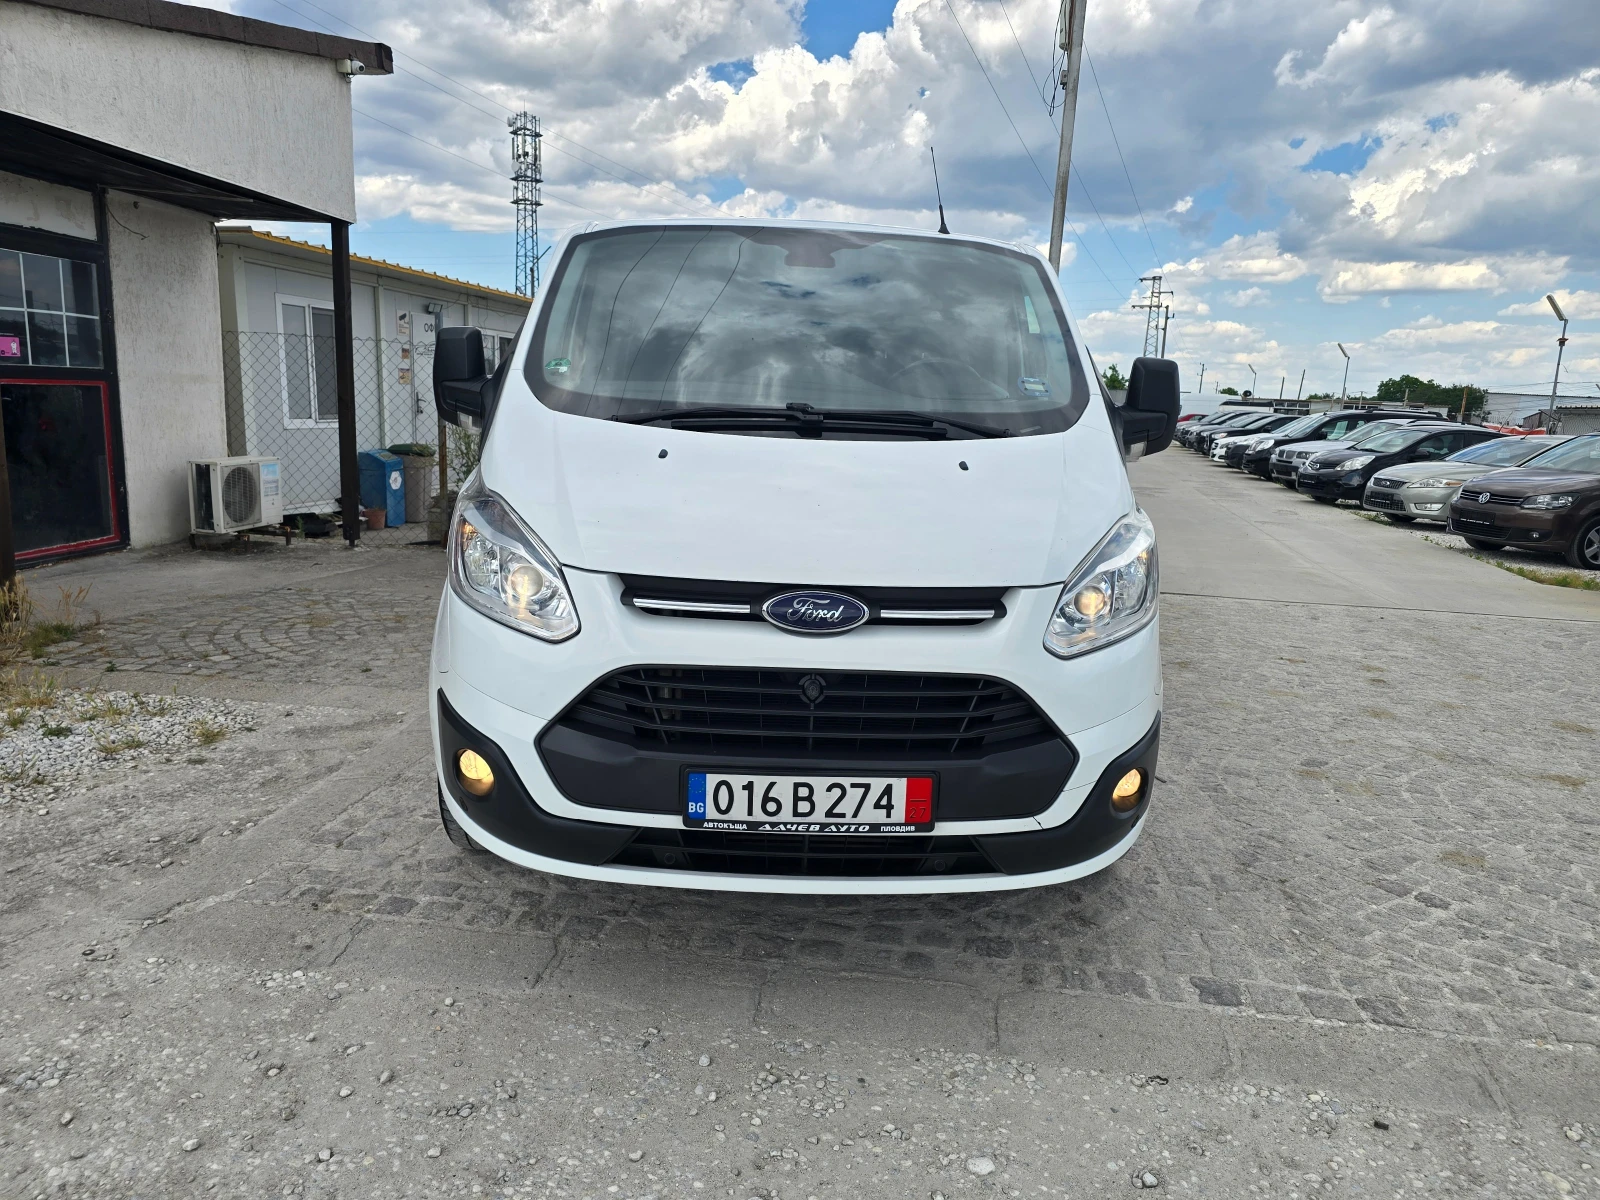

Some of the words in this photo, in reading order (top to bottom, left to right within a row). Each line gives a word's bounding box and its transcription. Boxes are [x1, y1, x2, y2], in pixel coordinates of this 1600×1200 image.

[786, 597, 845, 622] Ford
[688, 802, 704, 813] BG
[703, 822, 748, 830] АВТОКЪЩА
